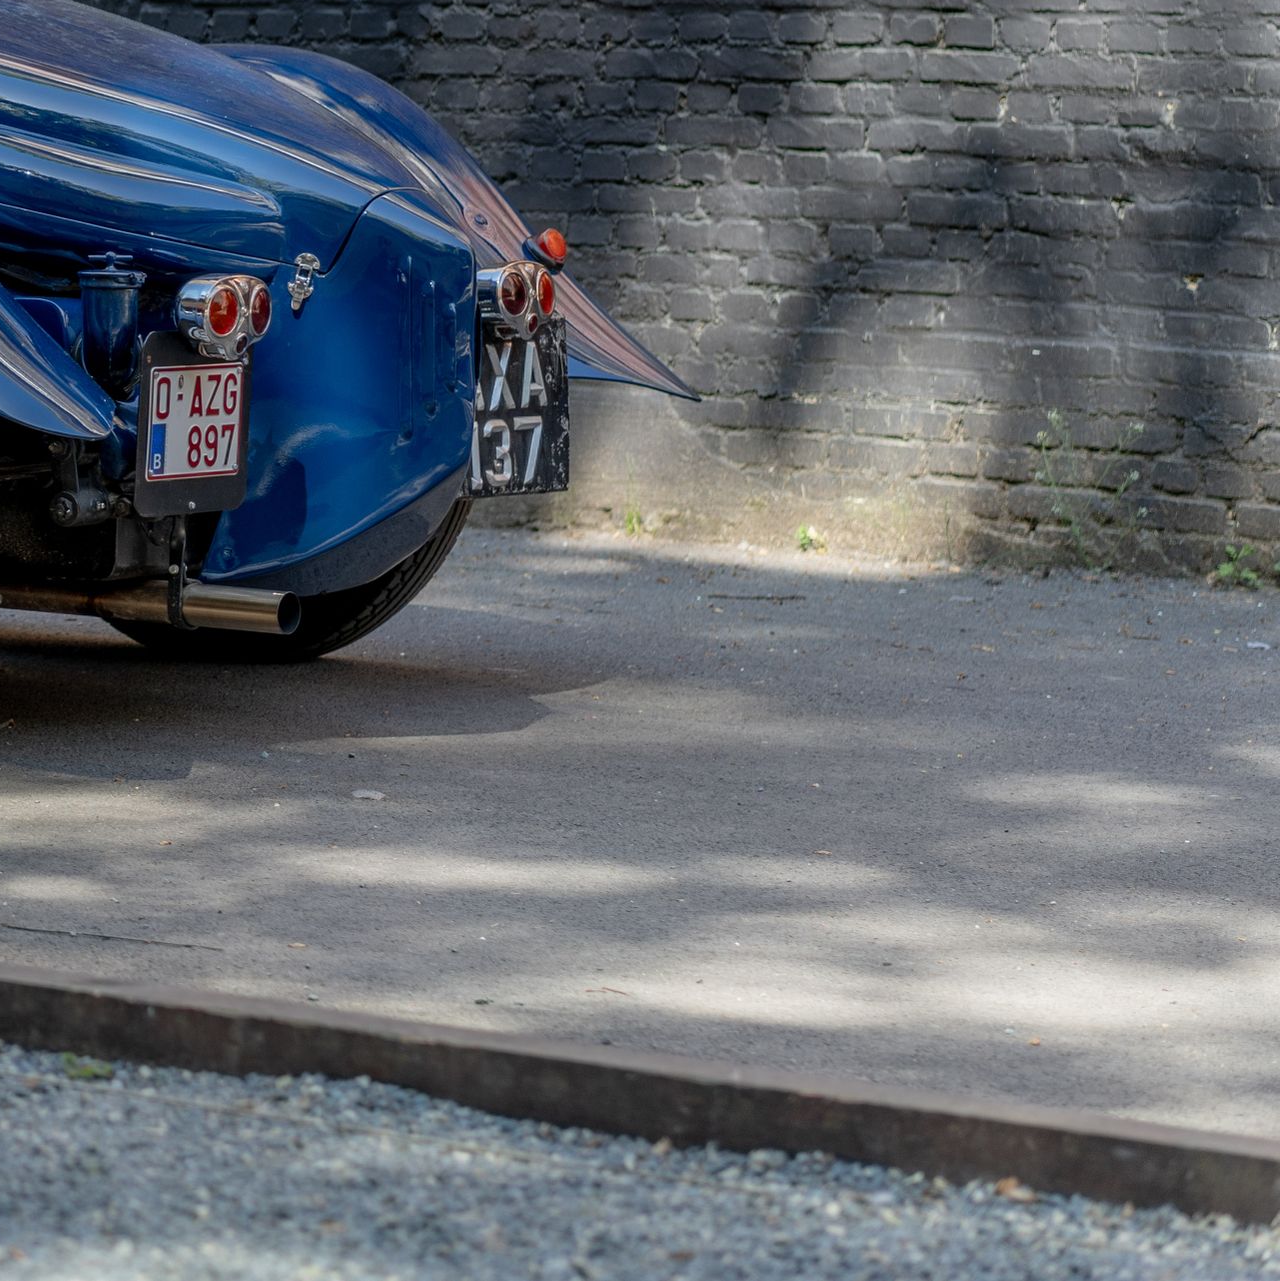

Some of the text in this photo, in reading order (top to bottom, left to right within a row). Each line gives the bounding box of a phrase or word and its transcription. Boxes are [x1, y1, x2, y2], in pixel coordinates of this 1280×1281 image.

[156, 373, 238, 420] O-AZG
[153, 453, 162, 470] B
[188, 424, 236, 468] 897
